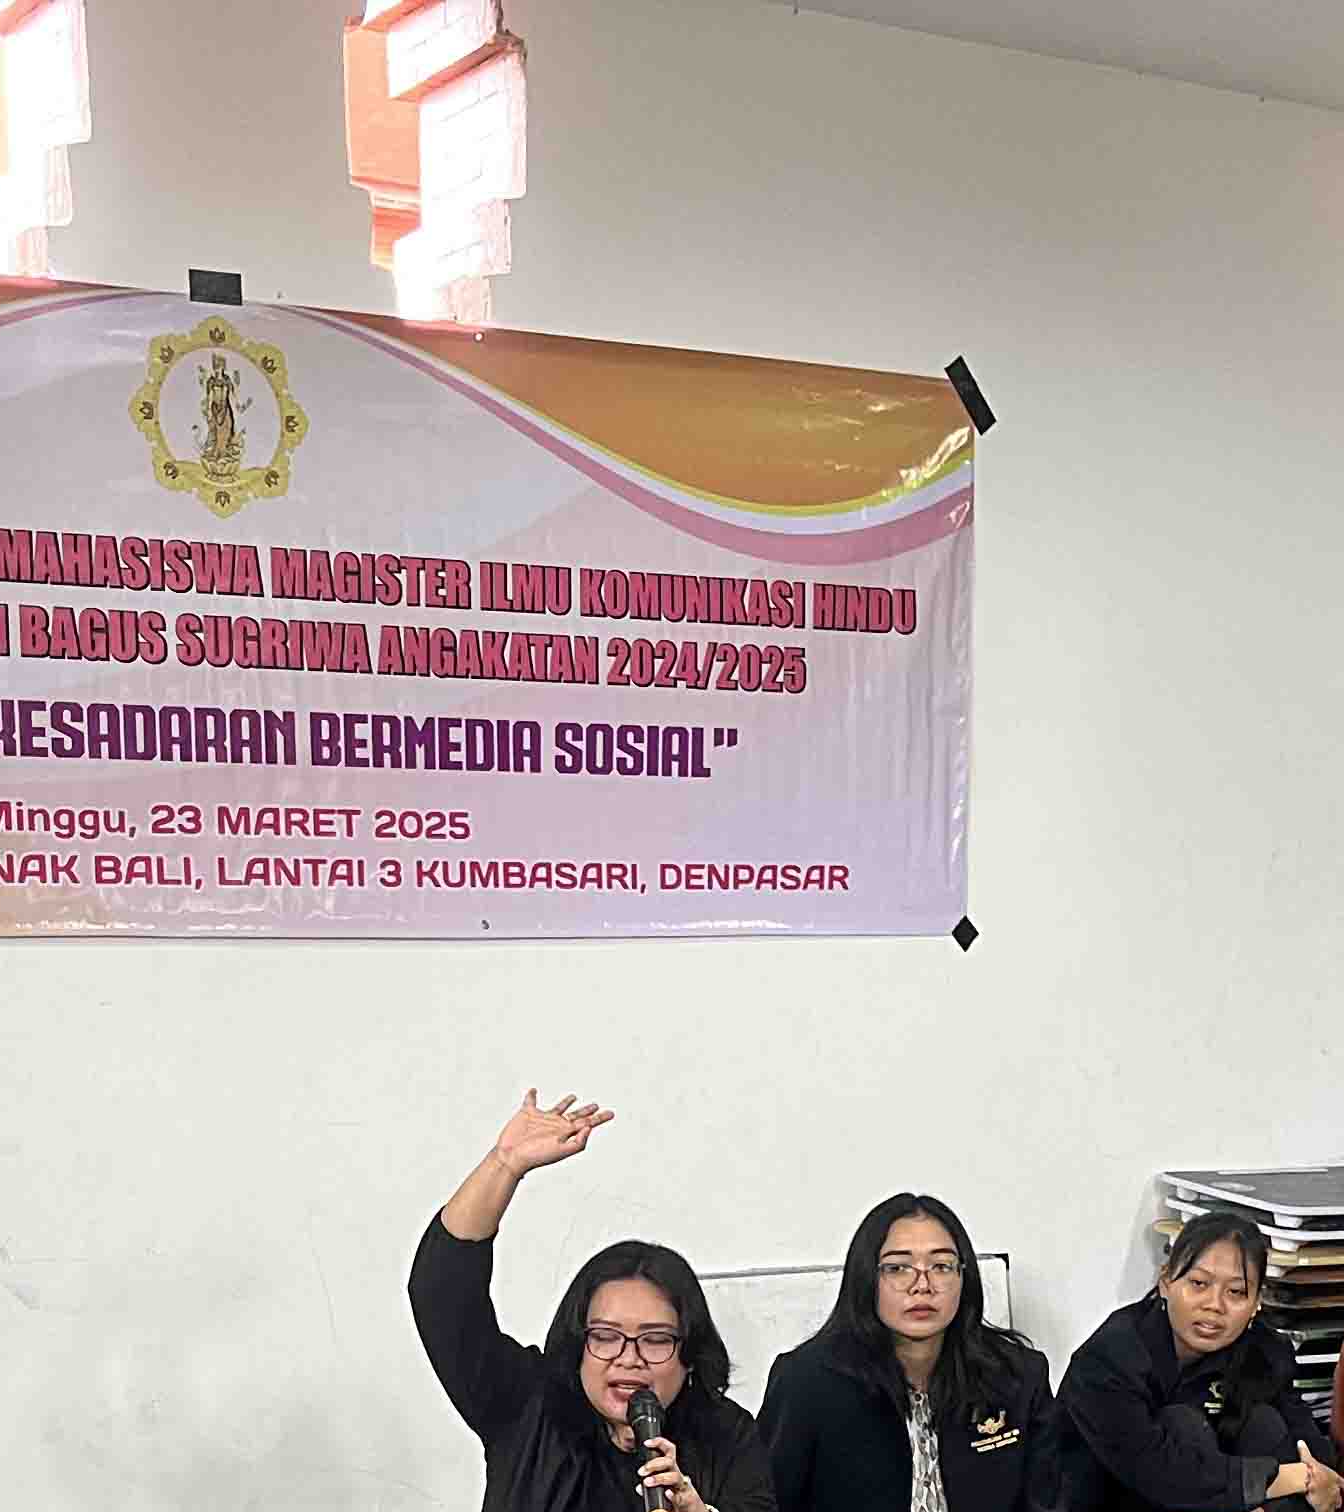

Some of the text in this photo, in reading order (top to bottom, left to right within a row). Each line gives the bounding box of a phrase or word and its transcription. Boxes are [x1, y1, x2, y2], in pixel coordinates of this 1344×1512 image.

[270, 547, 472, 609] MAGISTER
[479, 561, 571, 616] ILMU
[580, 568, 806, 630] KOMUNIKASI
[813, 582, 917, 635] HINDU
[19, 603, 168, 664] BAGUS
[175, 614, 373, 674] SUGRIWA
[377, 624, 600, 686] ANGAKATAN
[606, 637, 807, 694] 2024/2025
[309, 711, 542, 774] BERMEDIA
[151, 804, 203, 836] 23
[217, 806, 362, 838] MARET
[374, 809, 472, 840] 2025
[94, 854, 205, 892] BALI,
[217, 856, 366, 888] LANTAI
[378, 858, 404, 888] 3
[415, 860, 648, 894] KUMBASARI,
[659, 862, 851, 892] DENPASAR
